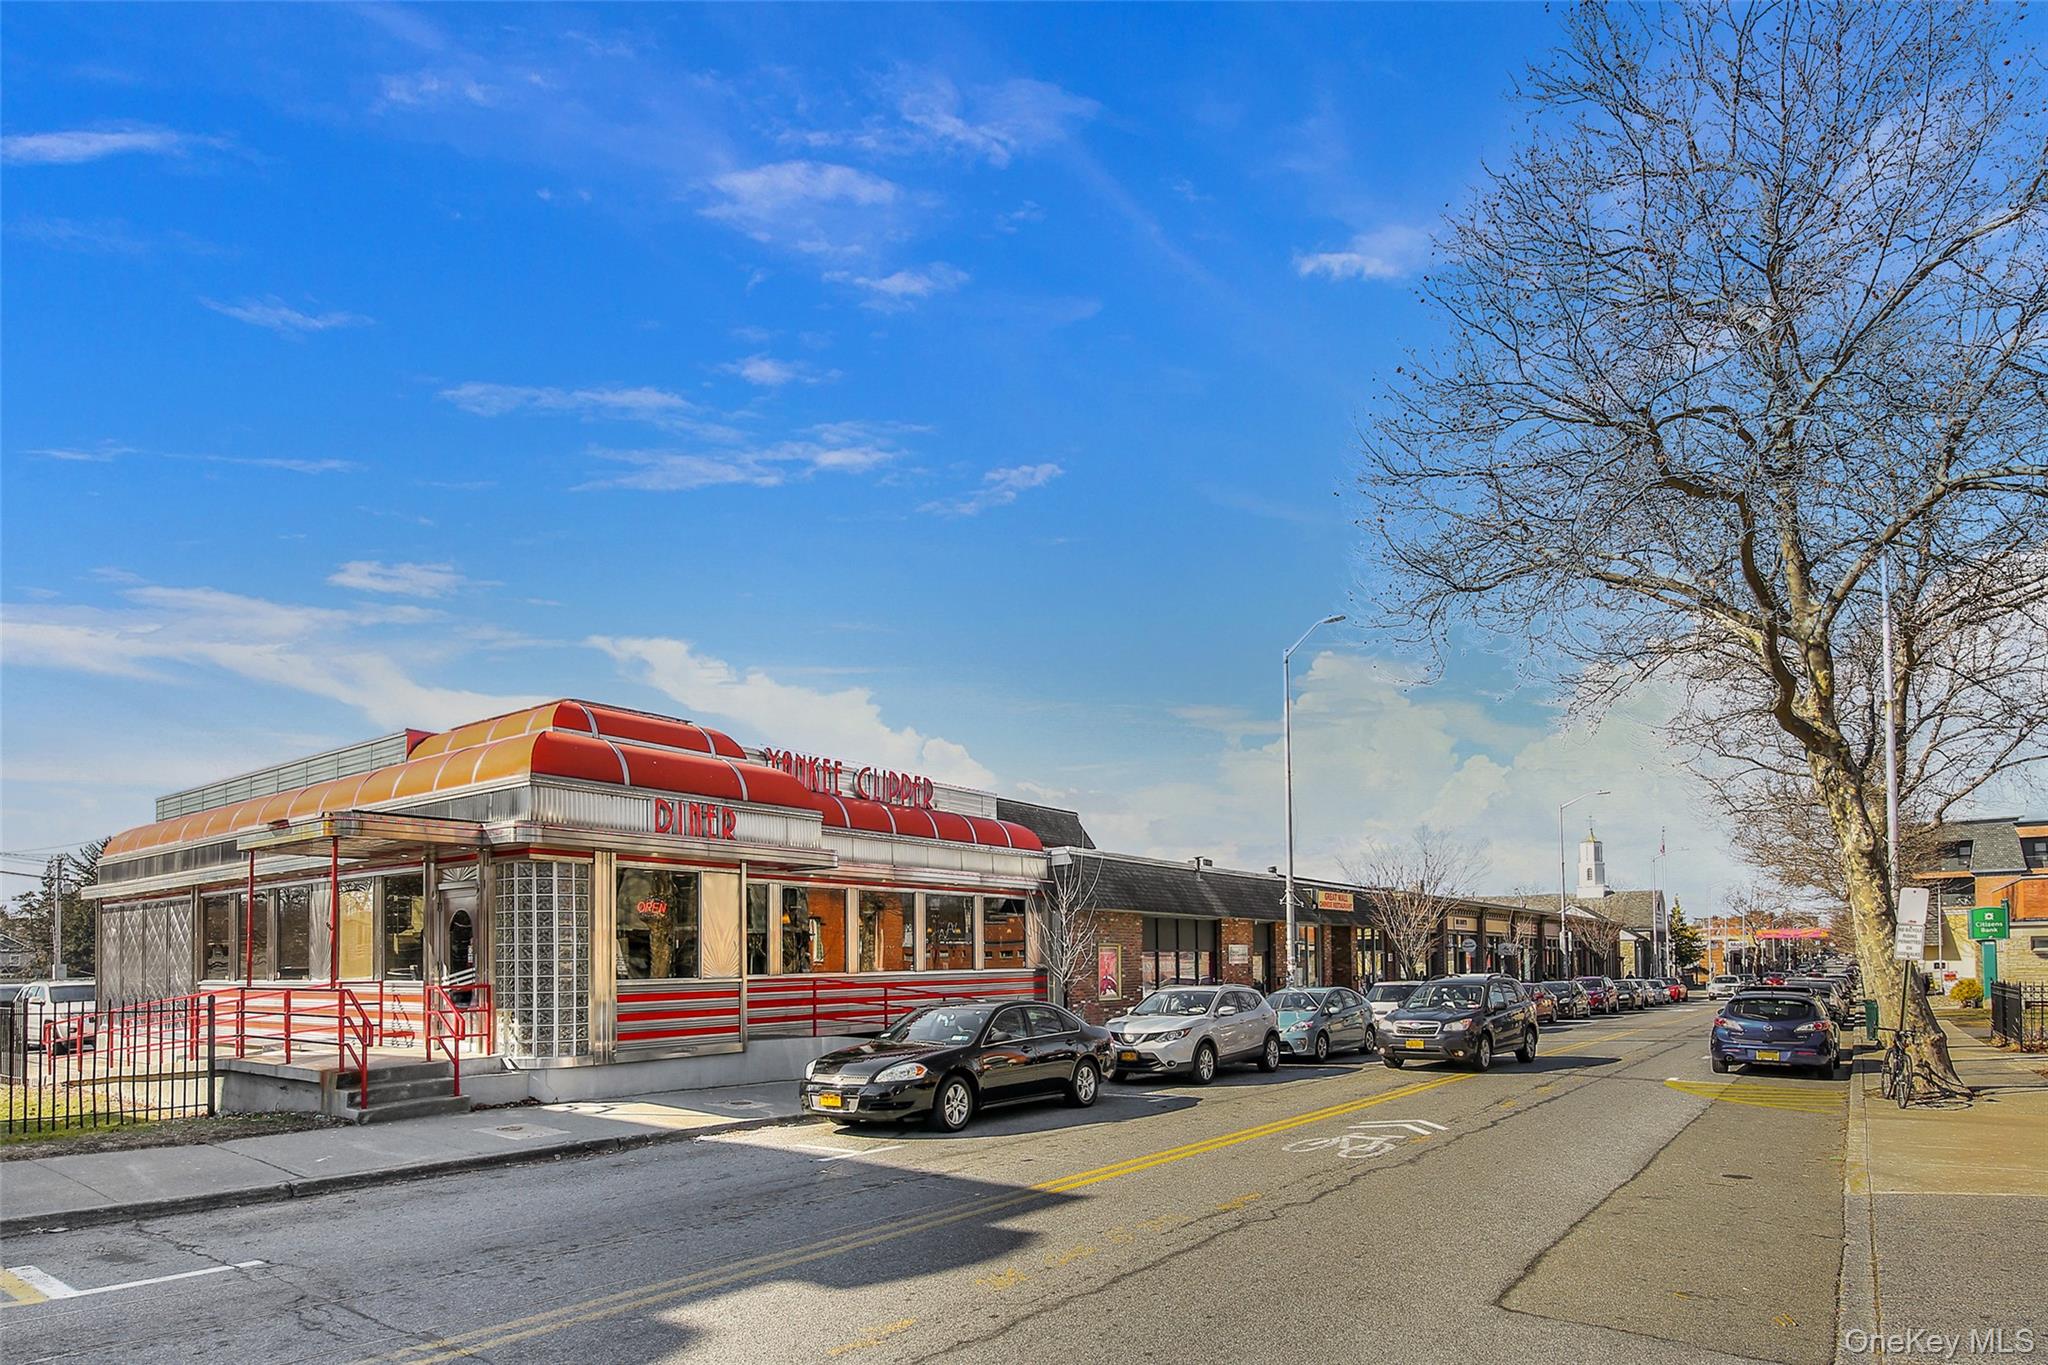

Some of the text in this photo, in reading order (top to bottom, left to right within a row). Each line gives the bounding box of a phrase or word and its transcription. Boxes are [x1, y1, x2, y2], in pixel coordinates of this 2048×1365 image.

[765, 747, 934, 809] YANKEE CLIPPER
[654, 797, 737, 840] DINER
[636, 901, 669, 914] OPEN
